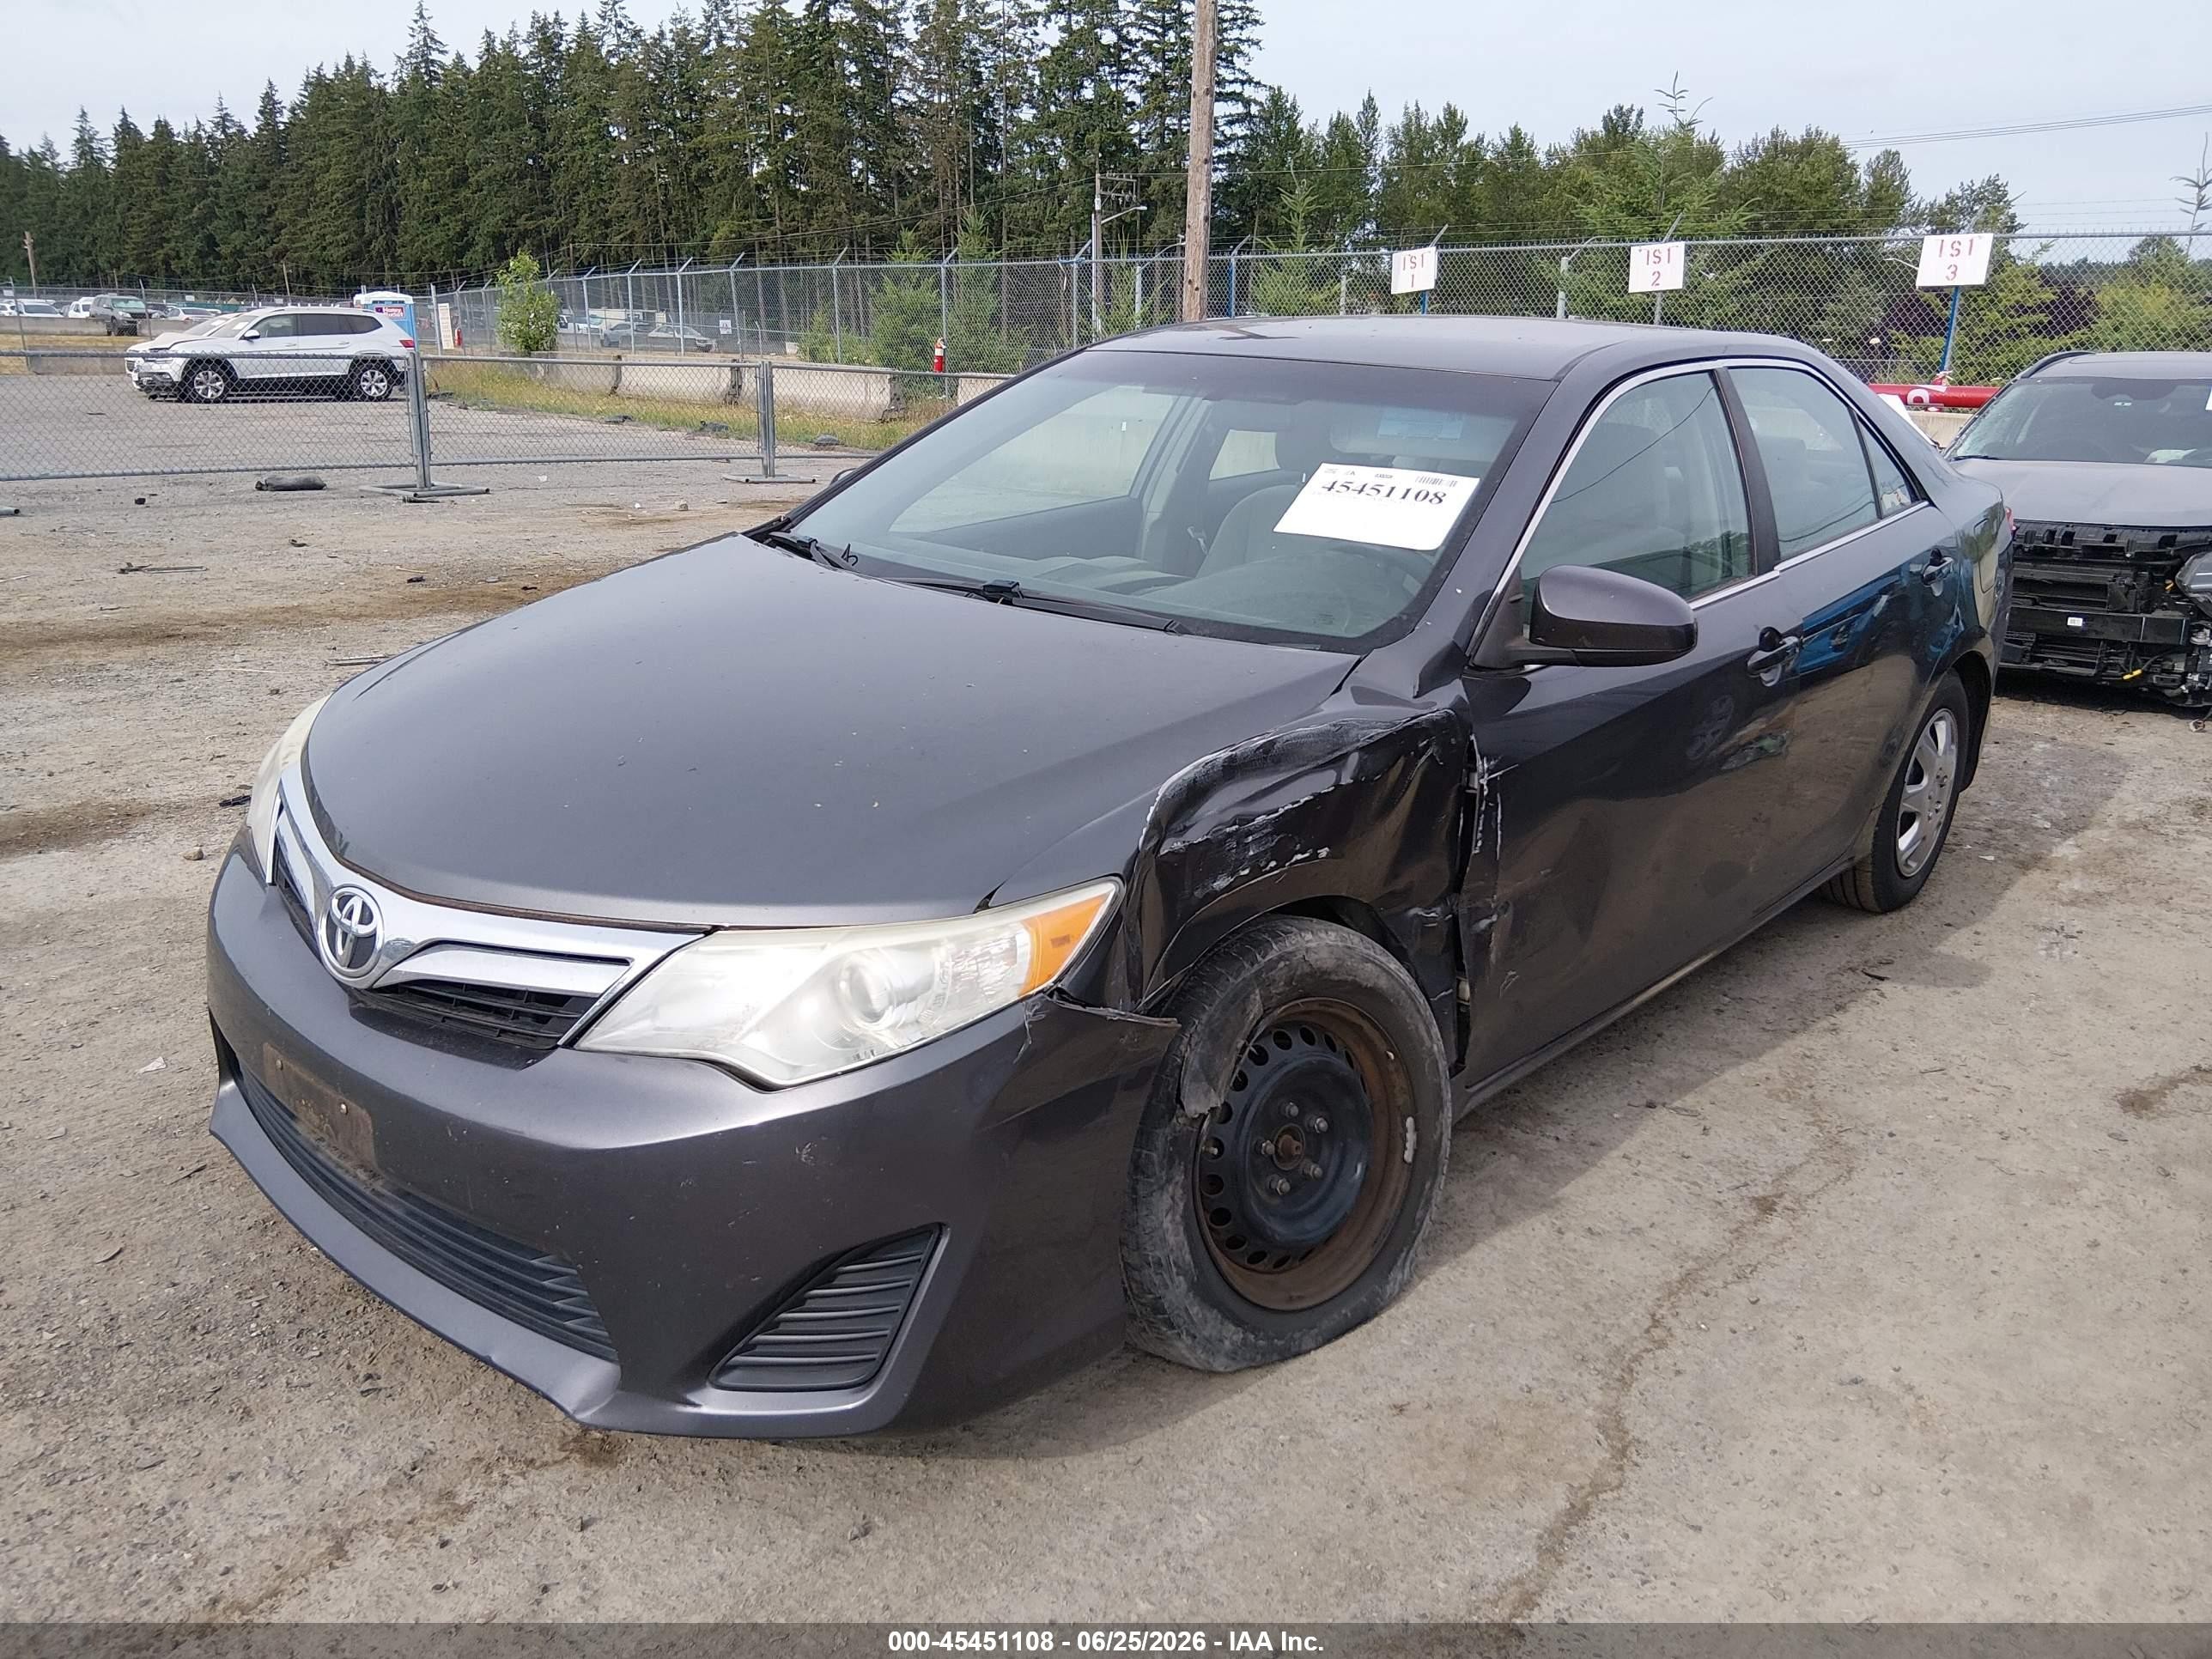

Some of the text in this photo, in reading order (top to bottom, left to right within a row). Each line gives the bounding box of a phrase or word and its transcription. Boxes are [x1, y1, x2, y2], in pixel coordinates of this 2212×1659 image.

[1650, 270, 1661, 287] 2
[1945, 264, 1958, 281] 3
[1321, 480, 1447, 505] 45451108
